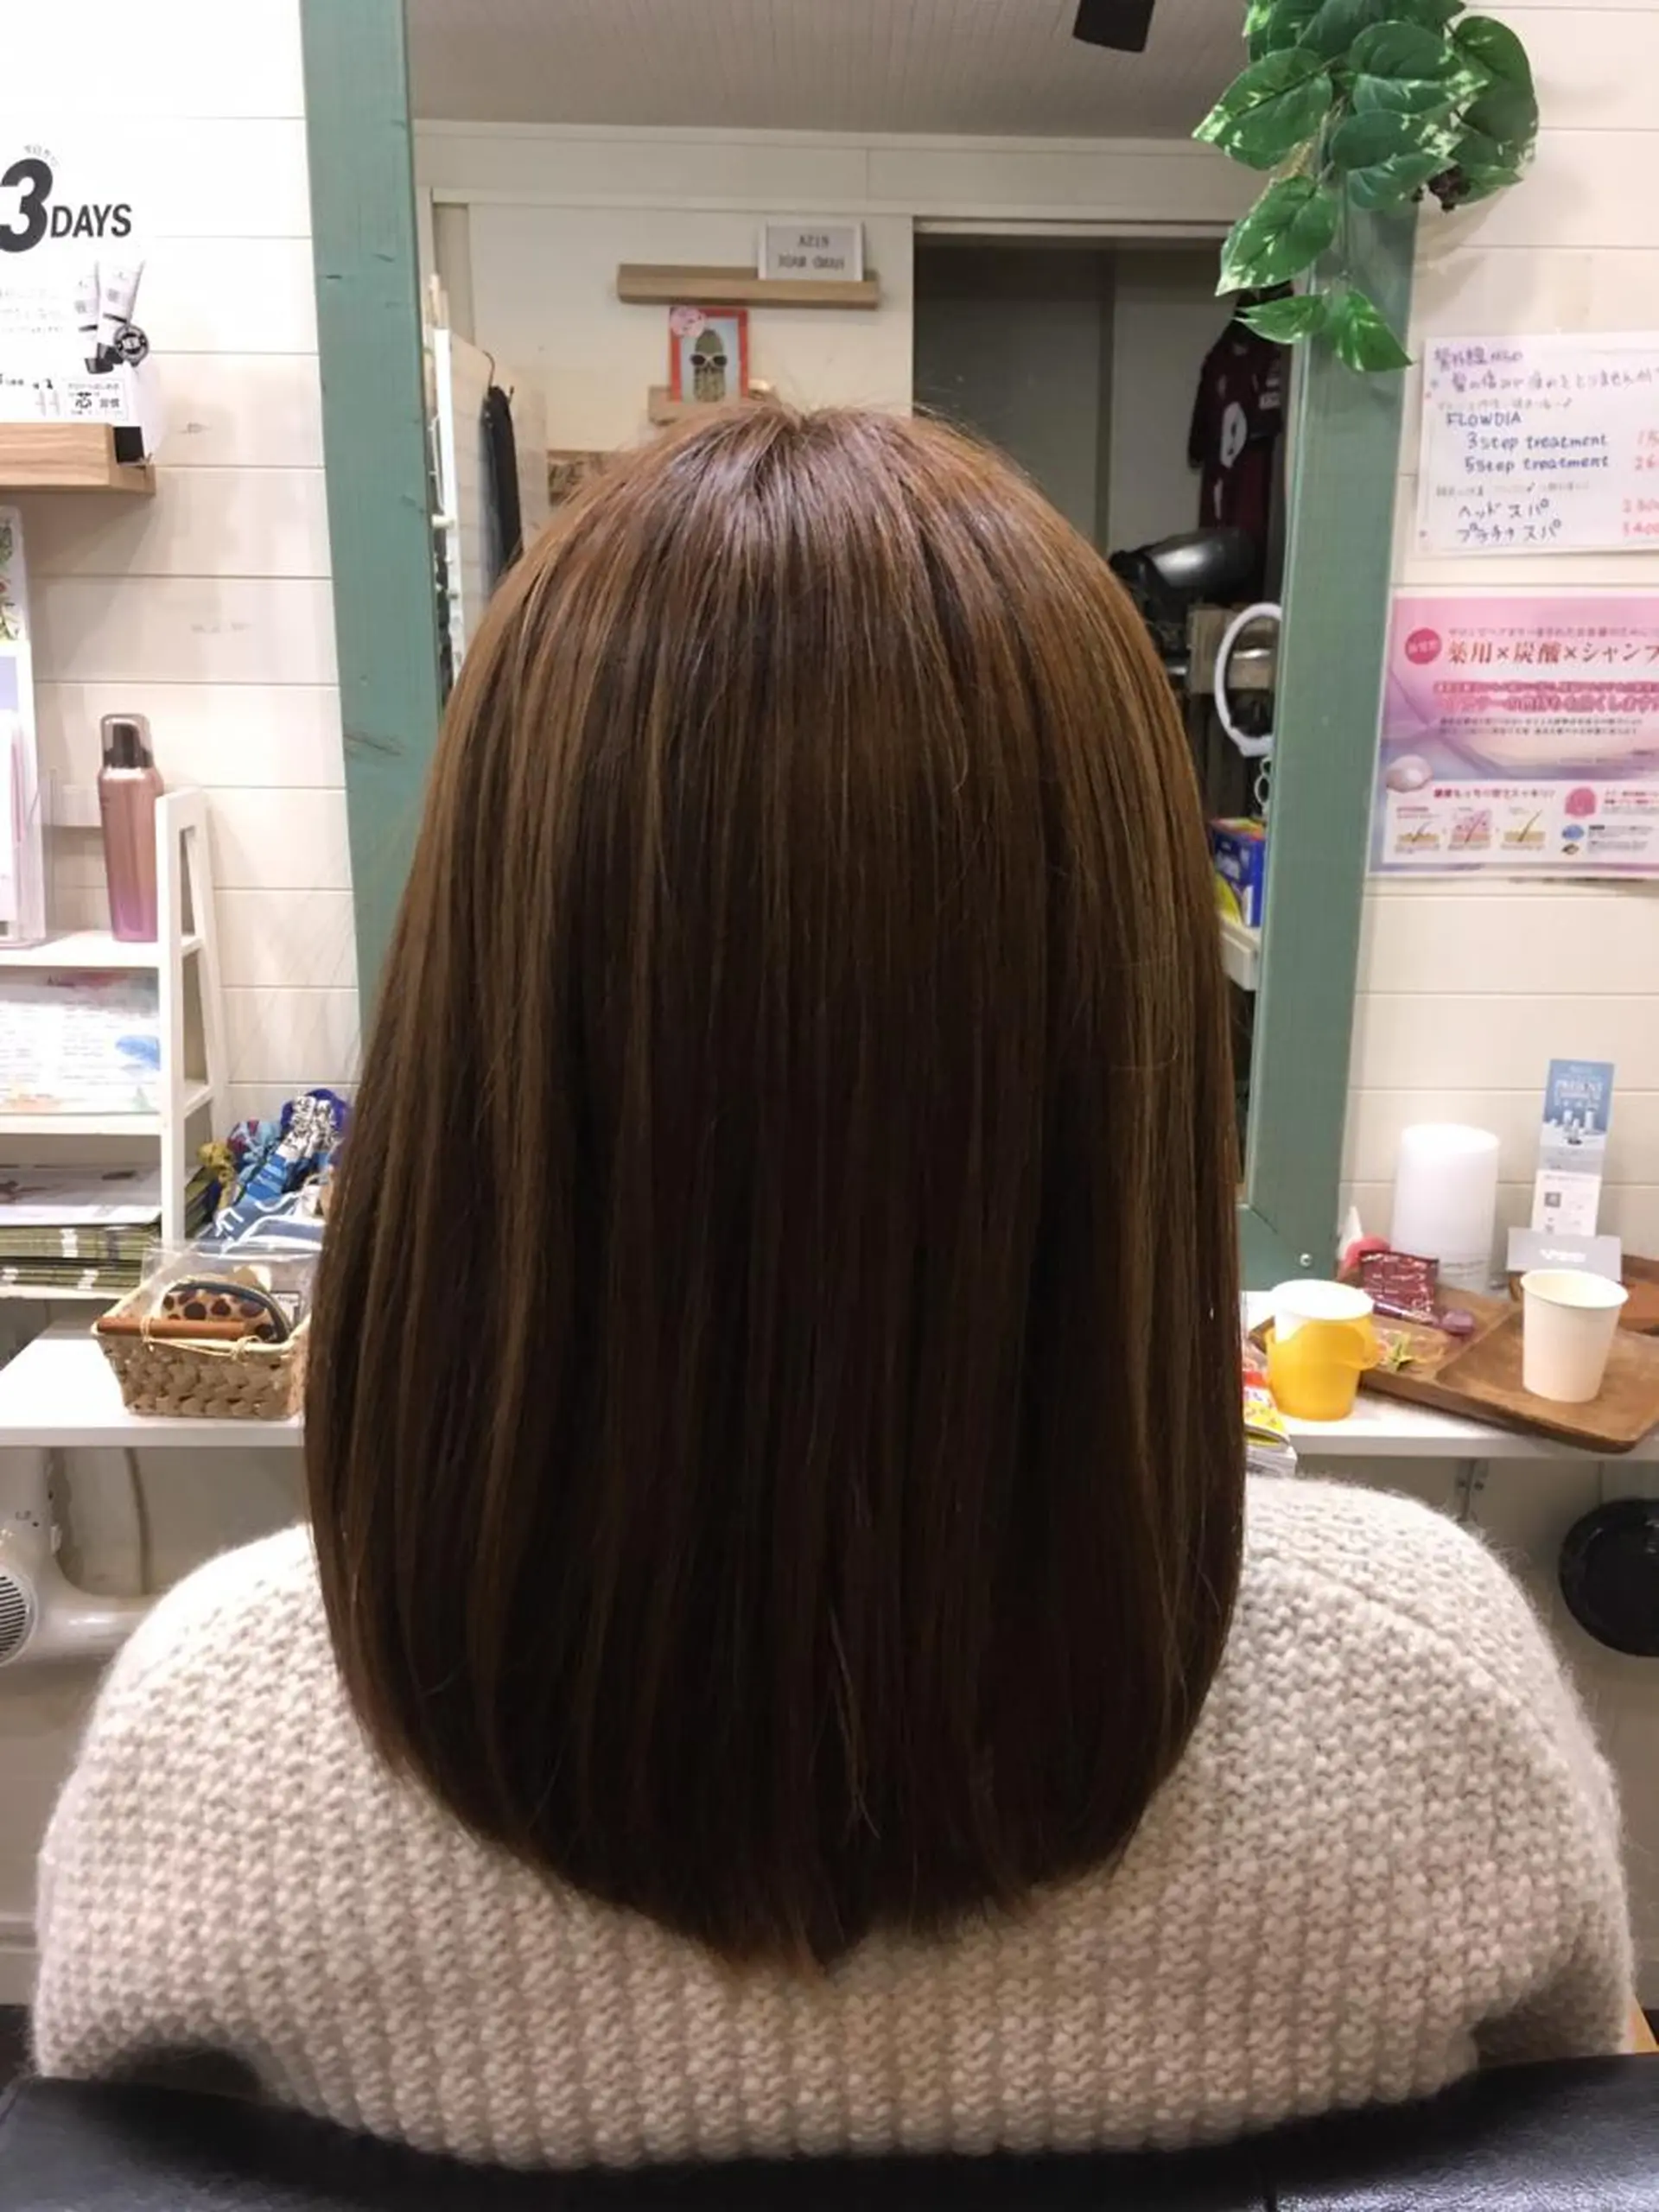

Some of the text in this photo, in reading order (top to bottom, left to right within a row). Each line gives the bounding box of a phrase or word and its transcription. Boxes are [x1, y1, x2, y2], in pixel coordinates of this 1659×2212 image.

[51, 204, 131, 238] DAYS
[1446, 410, 1522, 428] FLOWDIA
[1527, 433, 1608, 449] treatment
[1522, 455, 1609, 470] treatment
